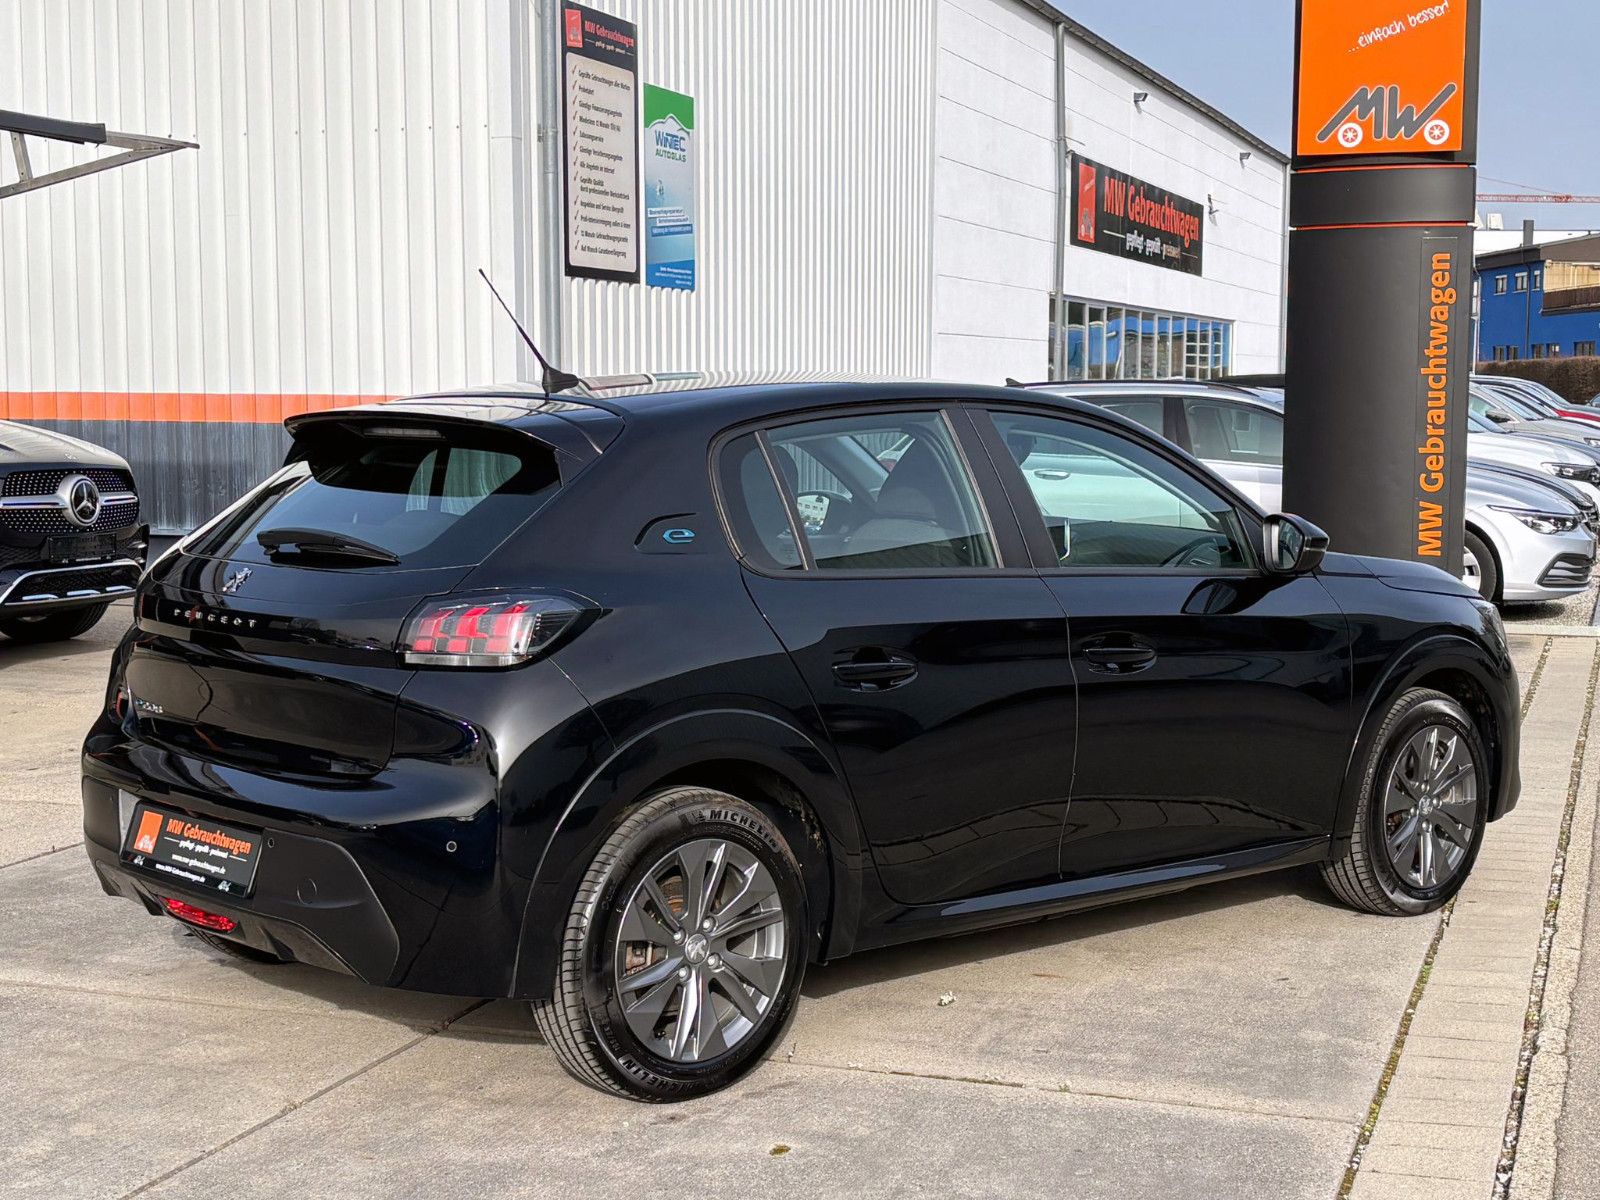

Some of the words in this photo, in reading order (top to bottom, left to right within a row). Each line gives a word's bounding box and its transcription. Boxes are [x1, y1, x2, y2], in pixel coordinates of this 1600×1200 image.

[1316, 82, 1457, 143] MW
[655, 148, 686, 163] AUTOGLAS
[1104, 176, 1126, 217] MW
[1128, 185, 1199, 248] Gebrauchtwagen
[1418, 251, 1457, 492] Gebrauchtwagen
[1417, 501, 1443, 557] MW
[173, 608, 257, 628] PEUGEOT
[166, 818, 184, 835] MW
[184, 824, 252, 855] Gebrauchtwagen
[709, 809, 777, 849] MICHELIN
